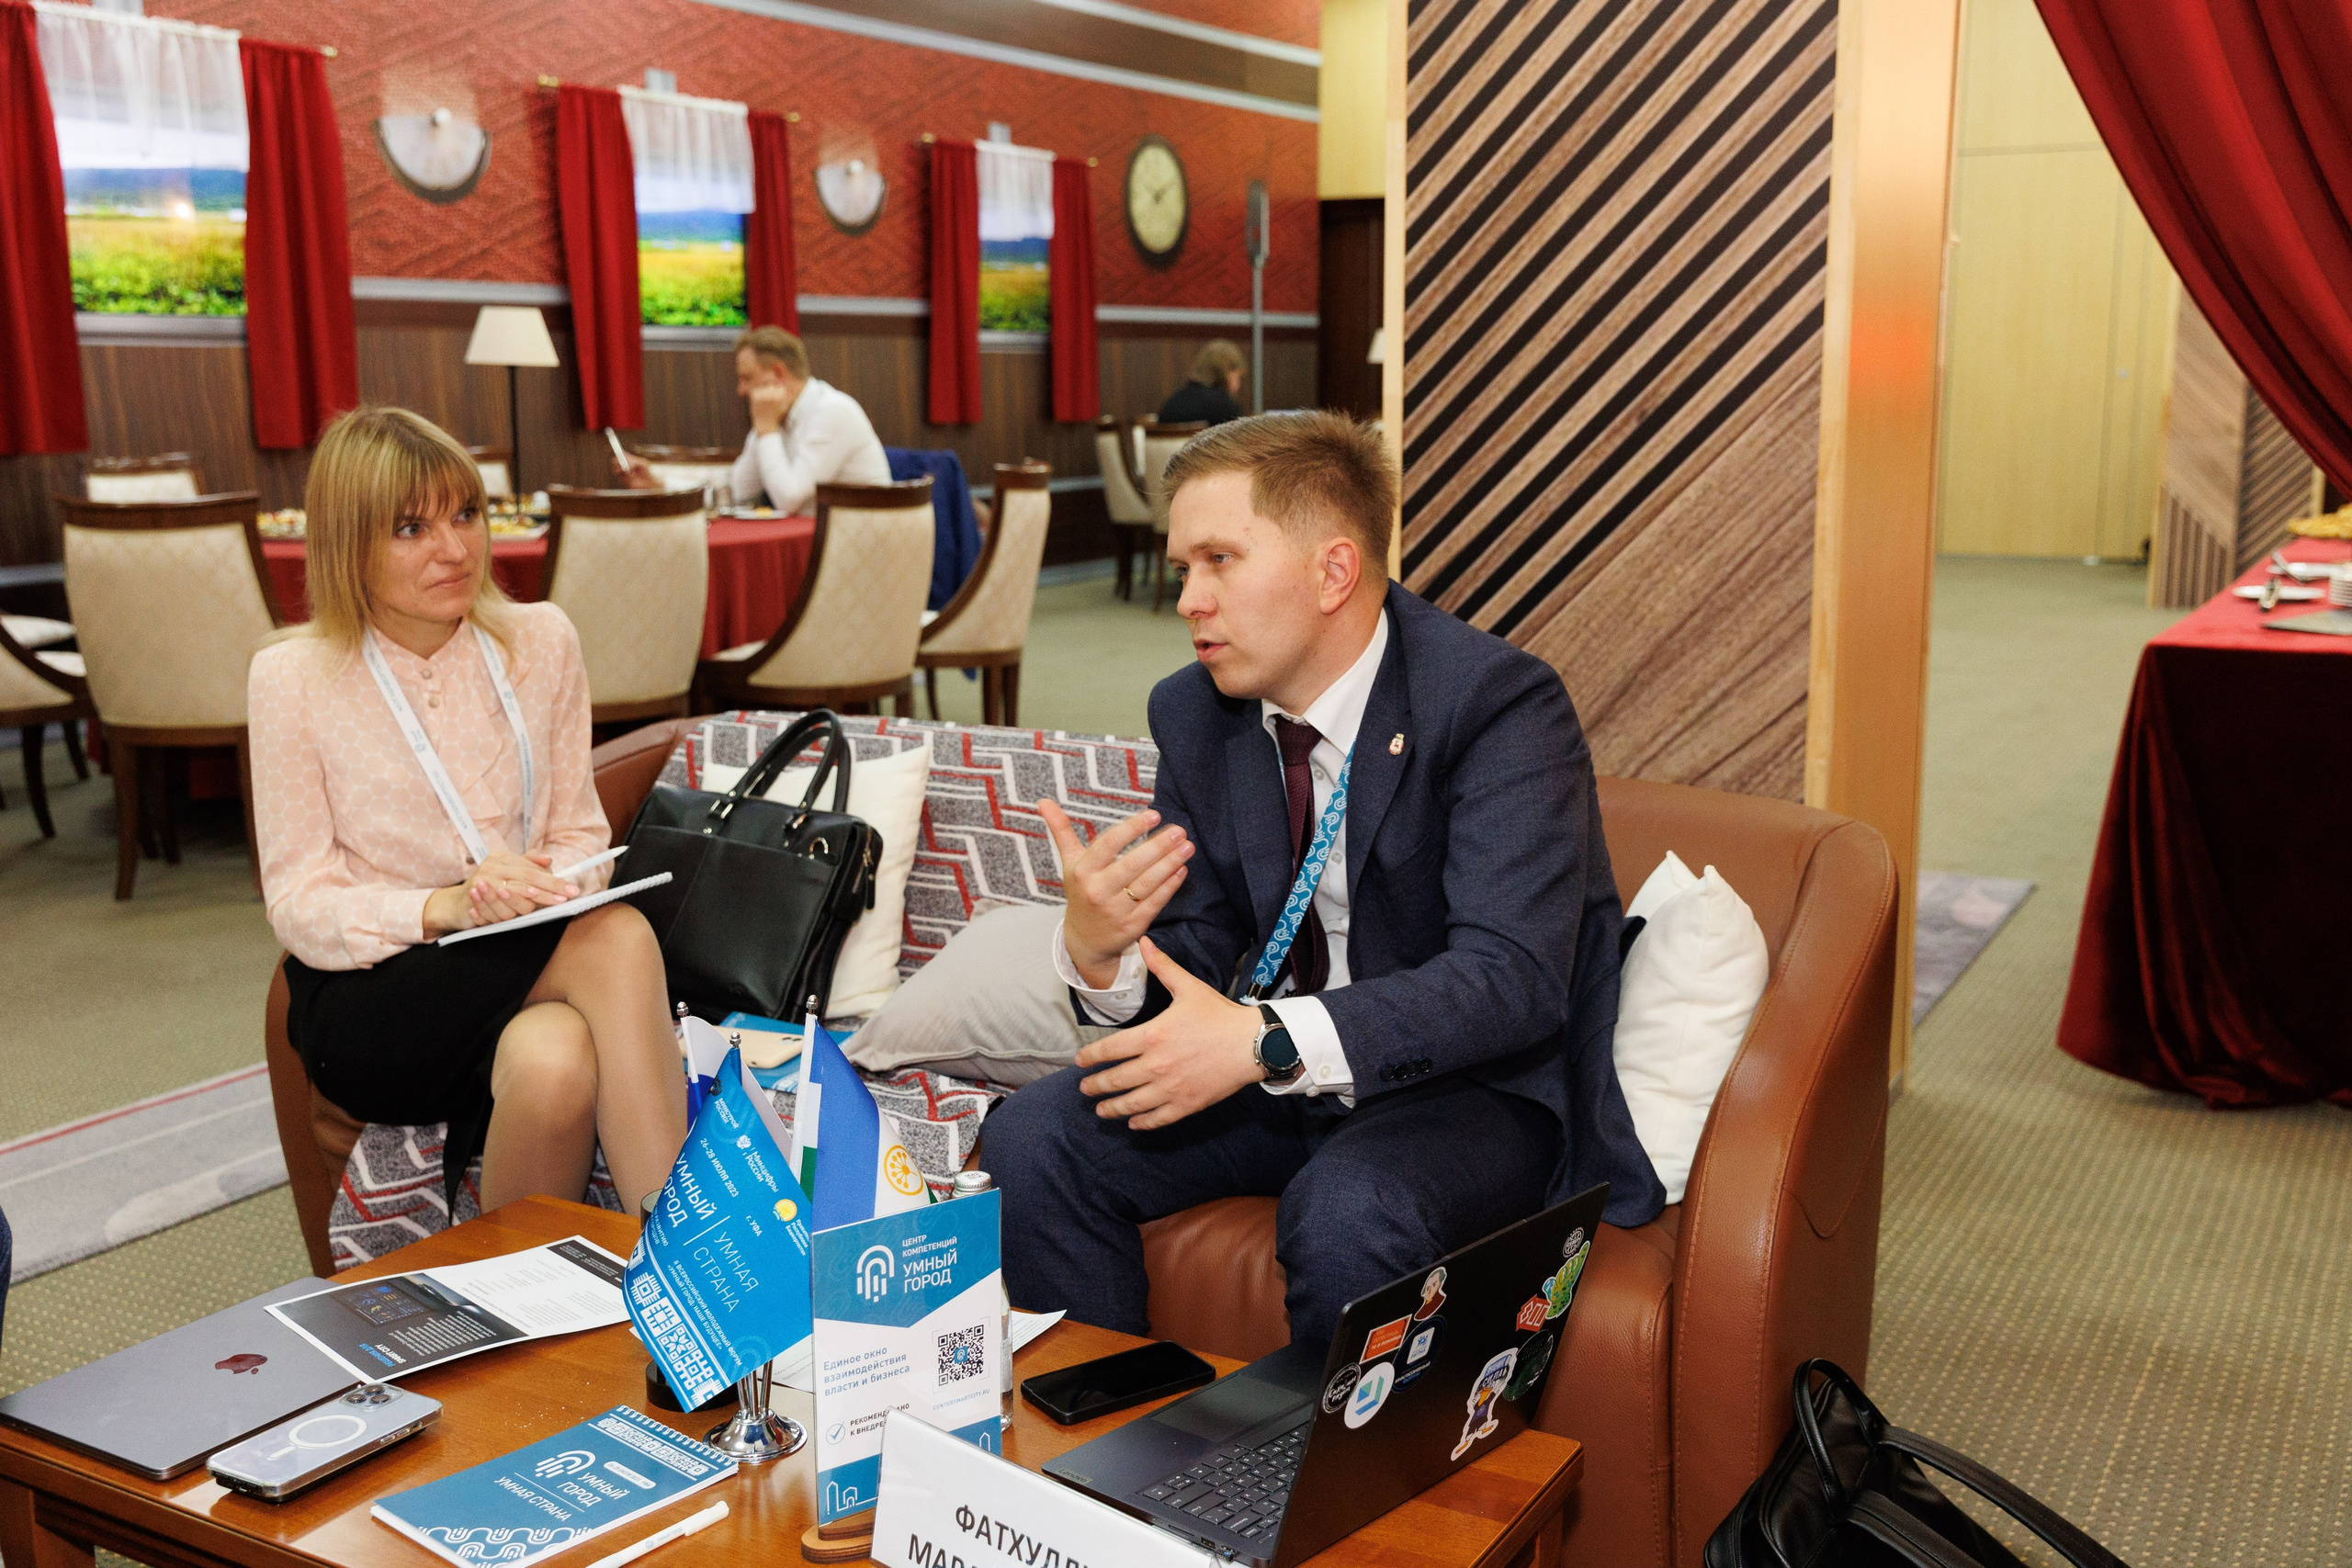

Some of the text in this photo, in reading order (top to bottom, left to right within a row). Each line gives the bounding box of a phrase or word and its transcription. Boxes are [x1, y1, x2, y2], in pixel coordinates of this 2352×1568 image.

[714, 1100, 729, 1124] РОССИИ
[718, 1098, 740, 1129] МИНСТРОЙ
[711, 1157, 729, 1182] ИЮЛЯ
[724, 1179, 740, 1198] 2023
[752, 1149, 779, 1193] Минцифры
[663, 1170, 689, 1228] ОРОД
[676, 1152, 718, 1221] УМНЫЙ
[750, 1220, 763, 1237] УФА
[902, 1235, 927, 1247] ЦЕНТР
[714, 1232, 759, 1292] УМНАЯ
[902, 1236, 957, 1258] КОМПЕТЕНЦИЙ
[903, 1247, 957, 1277] УМНЫЙ
[694, 1247, 740, 1313] СТРАНА
[904, 1269, 952, 1293] ГОРОД
[676, 1264, 708, 1310] ВСЕРОССИЙСКИЙ
[728, 1347, 743, 1367] ФОРУМ
[694, 1305, 707, 1322] НАШЕ
[823, 1355, 861, 1371] Единое
[864, 1348, 888, 1362] окно
[824, 1353, 907, 1383] взаимодействия
[824, 1365, 910, 1396] власти и бизнеса
[933, 1389, 990, 1411] CENTERSMARTCITY.RU
[577, 1472, 630, 1500] УМНЫЙ
[1058, 1469, 1087, 1483] Lenovo
[493, 1476, 571, 1522] УМНАЯ СТРАНА
[557, 1481, 602, 1507] ГОРОД
